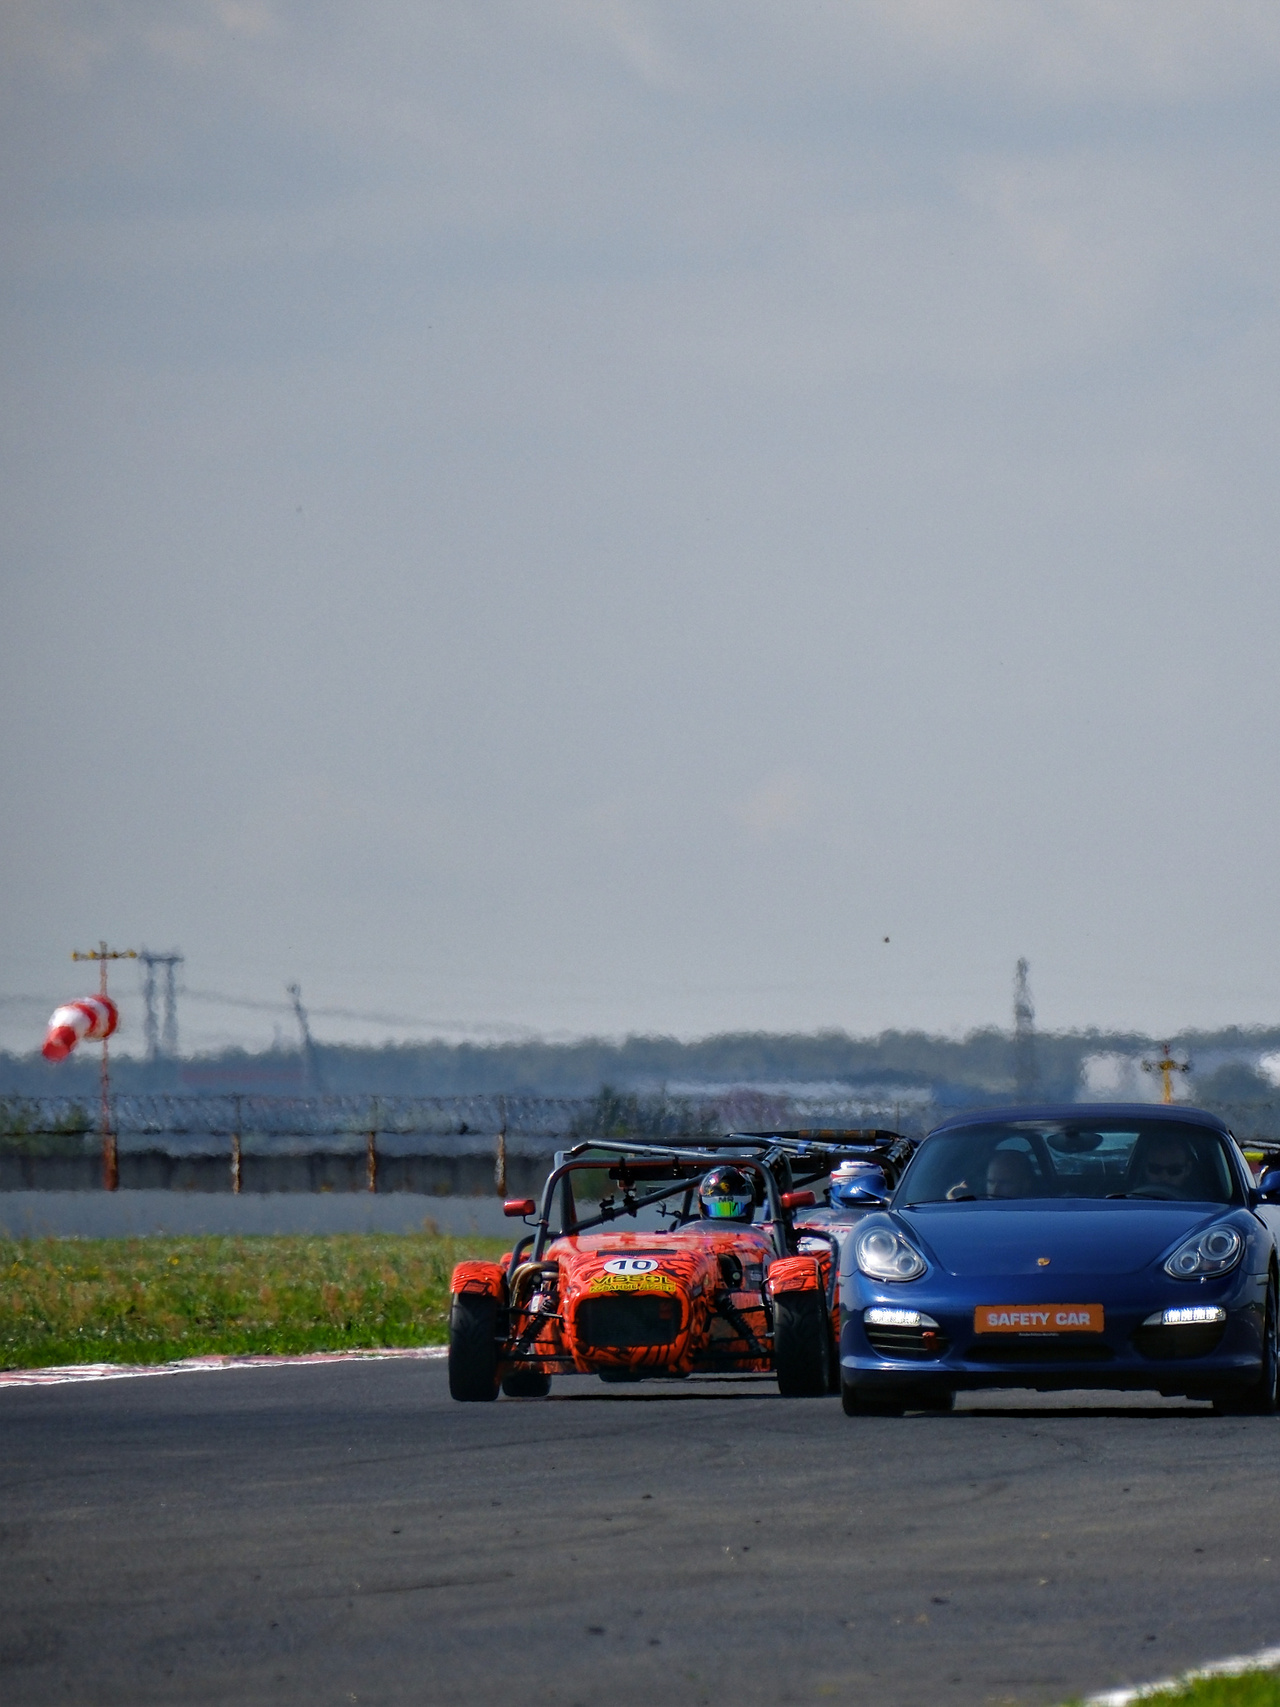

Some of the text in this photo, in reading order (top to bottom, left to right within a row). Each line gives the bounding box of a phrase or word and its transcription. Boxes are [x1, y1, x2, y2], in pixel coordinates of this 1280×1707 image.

[612, 1260, 652, 1270] 10
[988, 1312, 1091, 1326] SAFETY CAR
